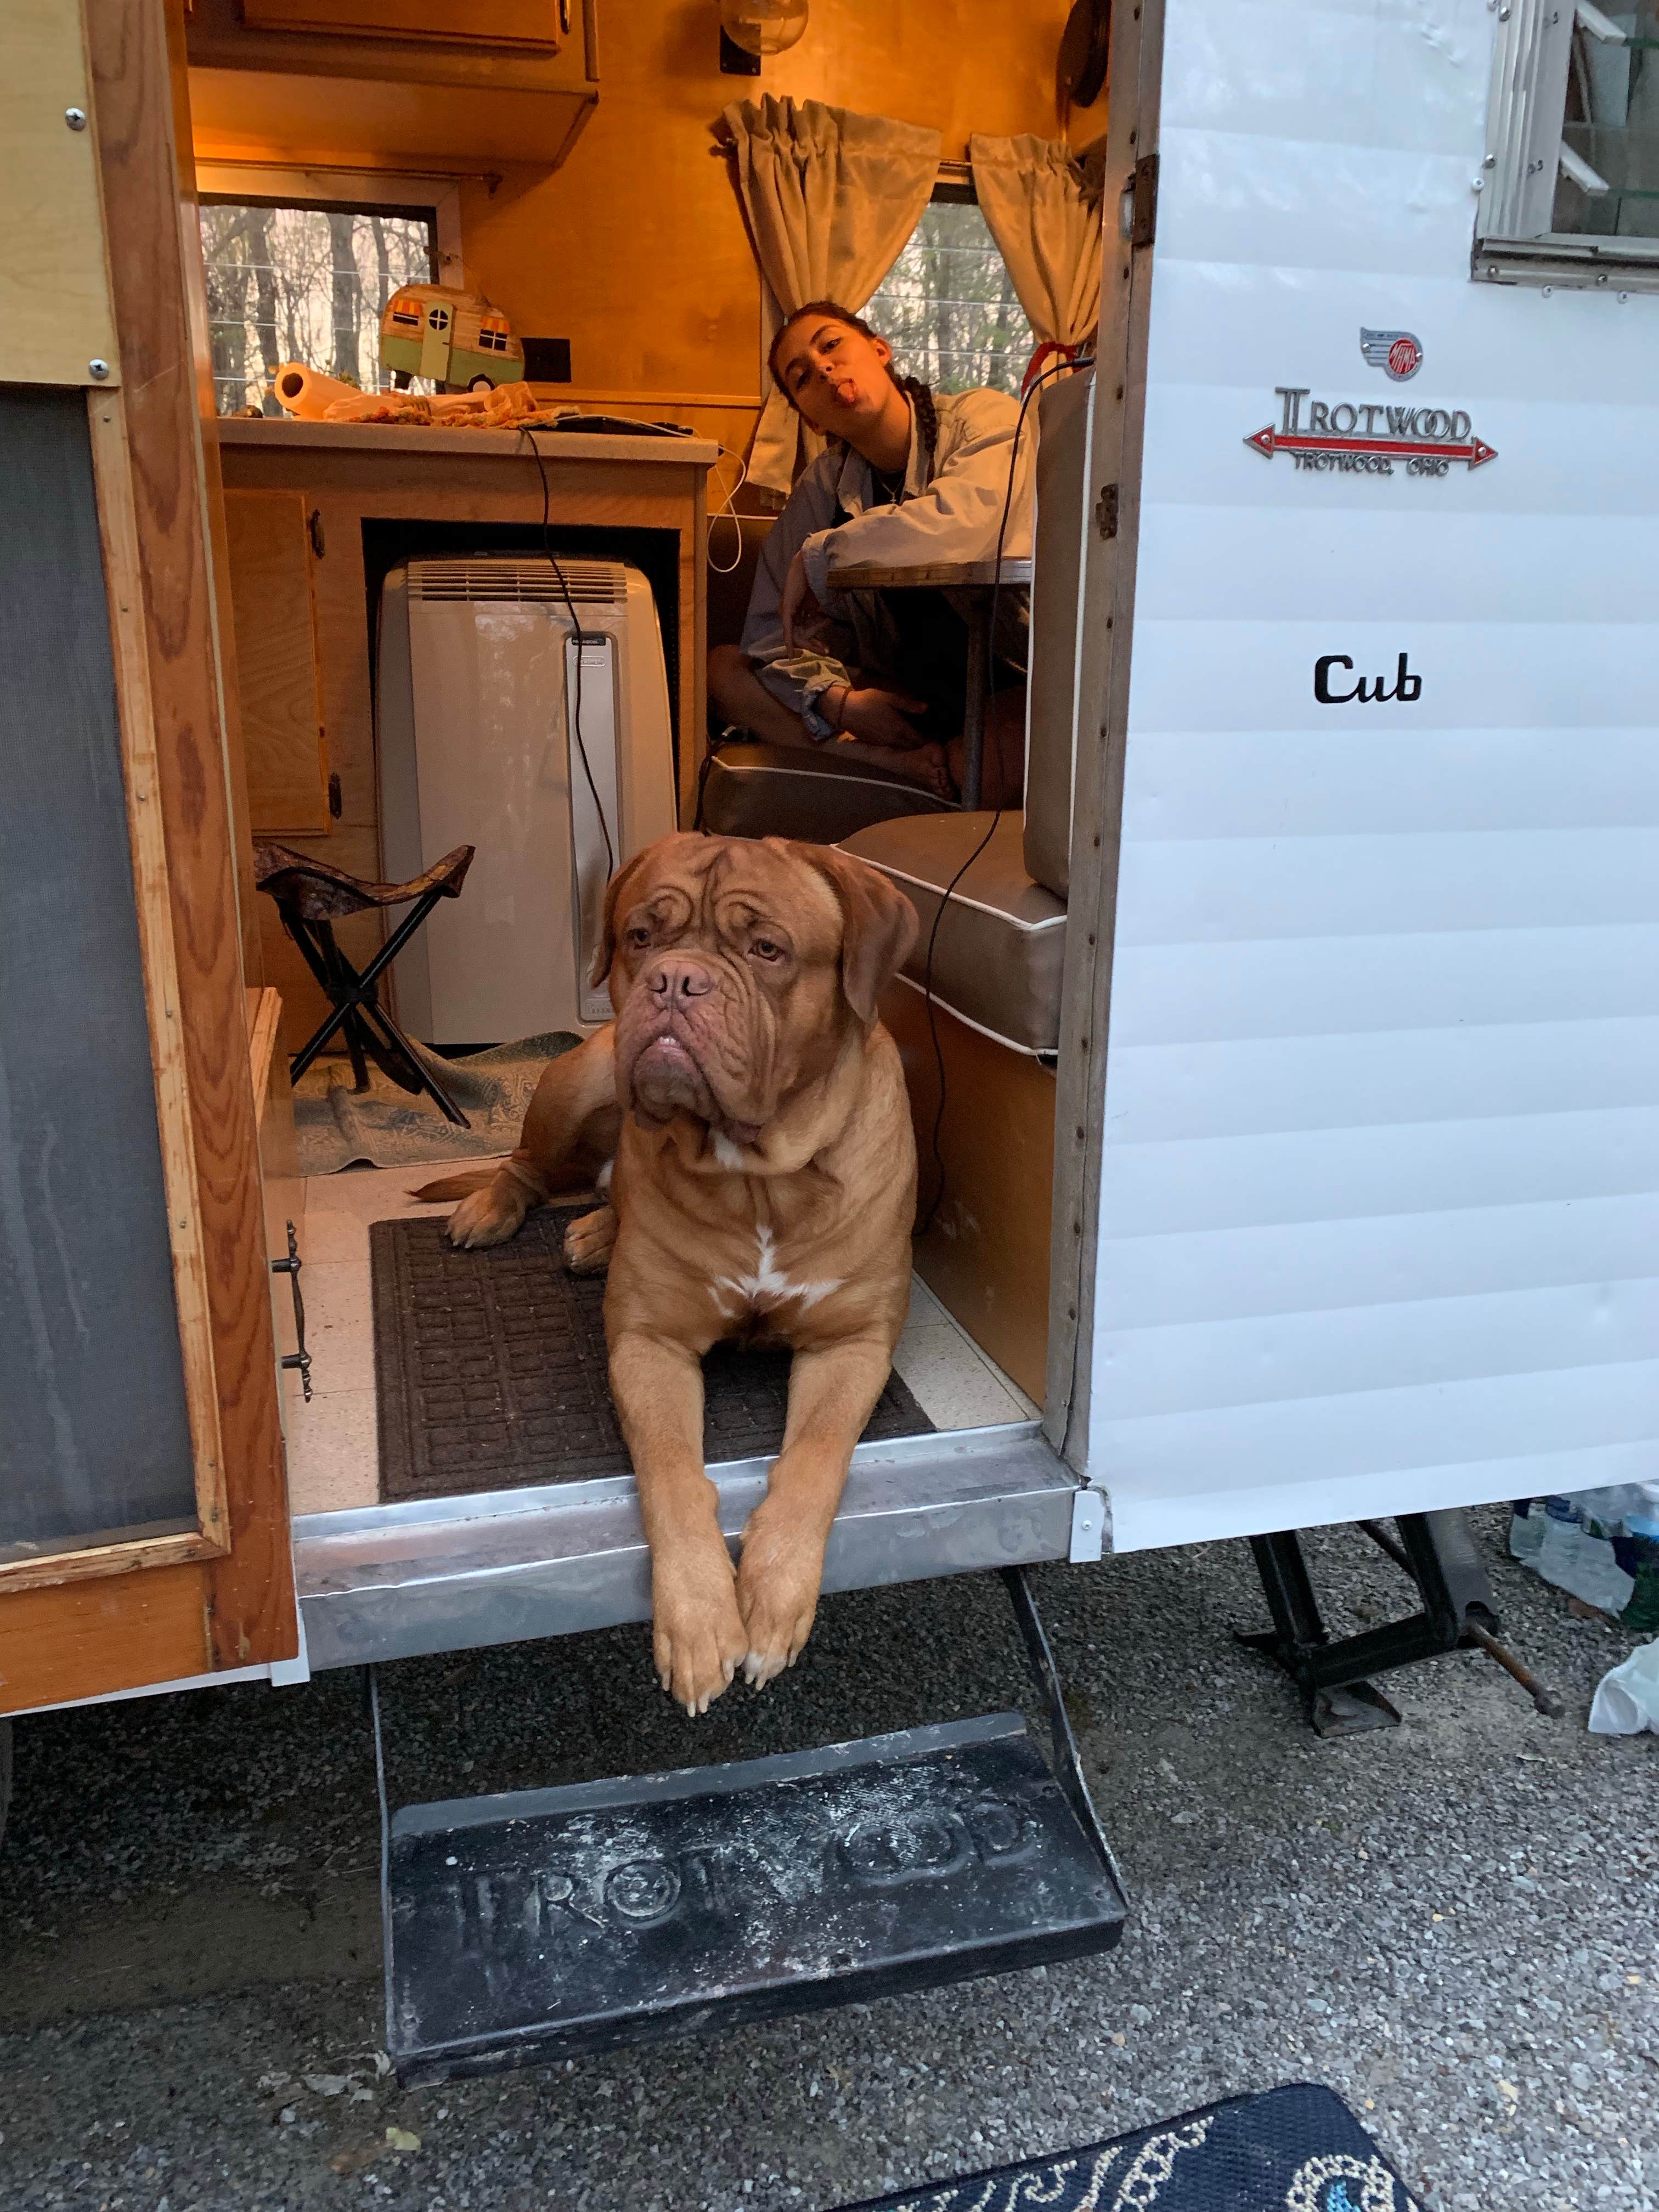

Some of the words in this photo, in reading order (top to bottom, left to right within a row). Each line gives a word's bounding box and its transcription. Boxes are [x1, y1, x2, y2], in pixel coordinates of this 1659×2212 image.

[1274, 387, 1471, 441] TROTWOOD
[1406, 458, 1449, 476] OHIO
[1314, 652, 1422, 703] Cub
